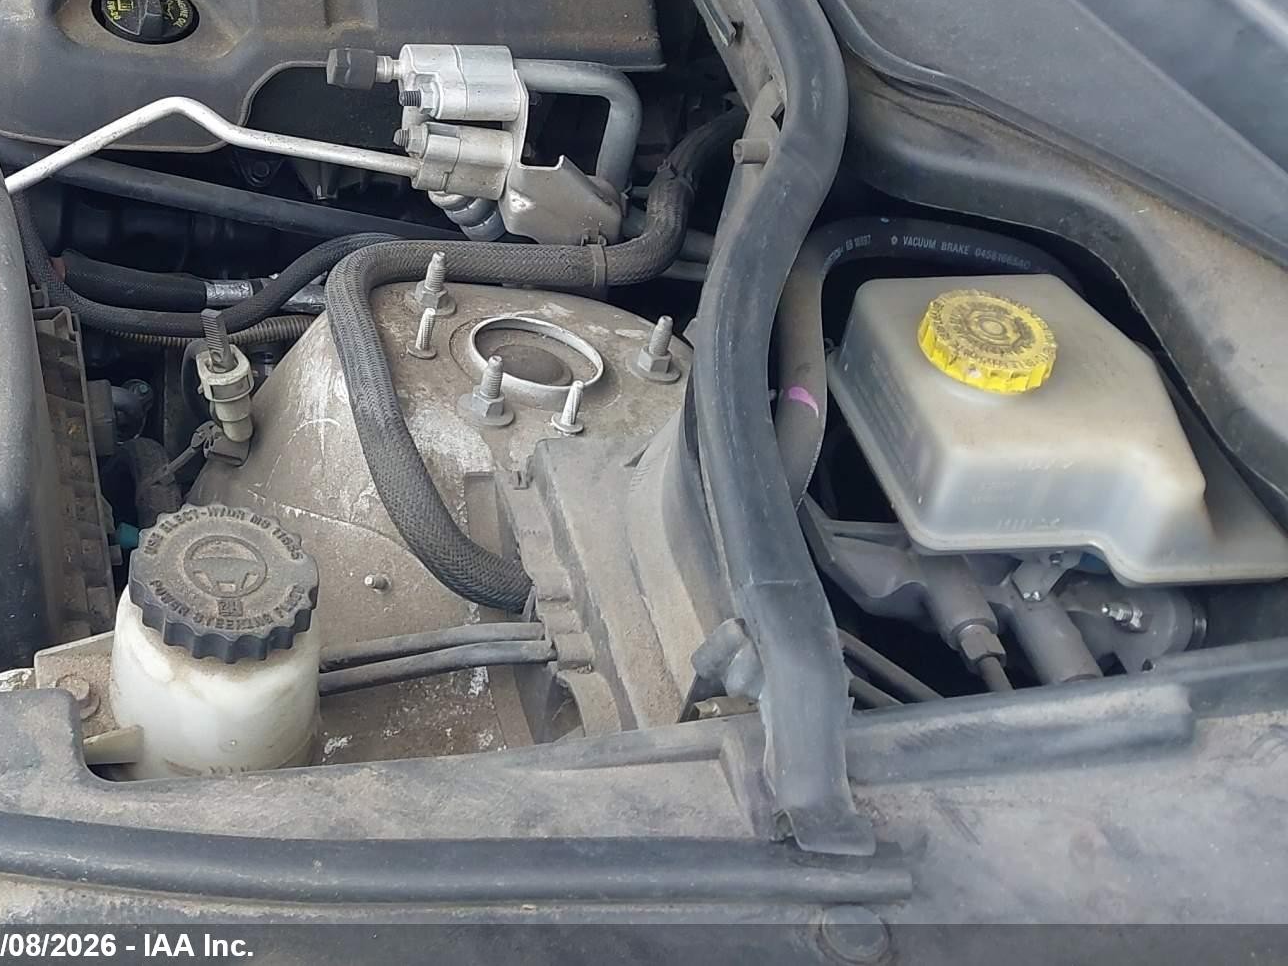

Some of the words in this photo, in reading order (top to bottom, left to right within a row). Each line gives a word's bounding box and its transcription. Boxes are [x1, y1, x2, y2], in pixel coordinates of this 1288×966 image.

[173, 18, 187, 28] OIL
[902, 235, 937, 250] VACUUM
[940, 240, 970, 255] BRAKE
